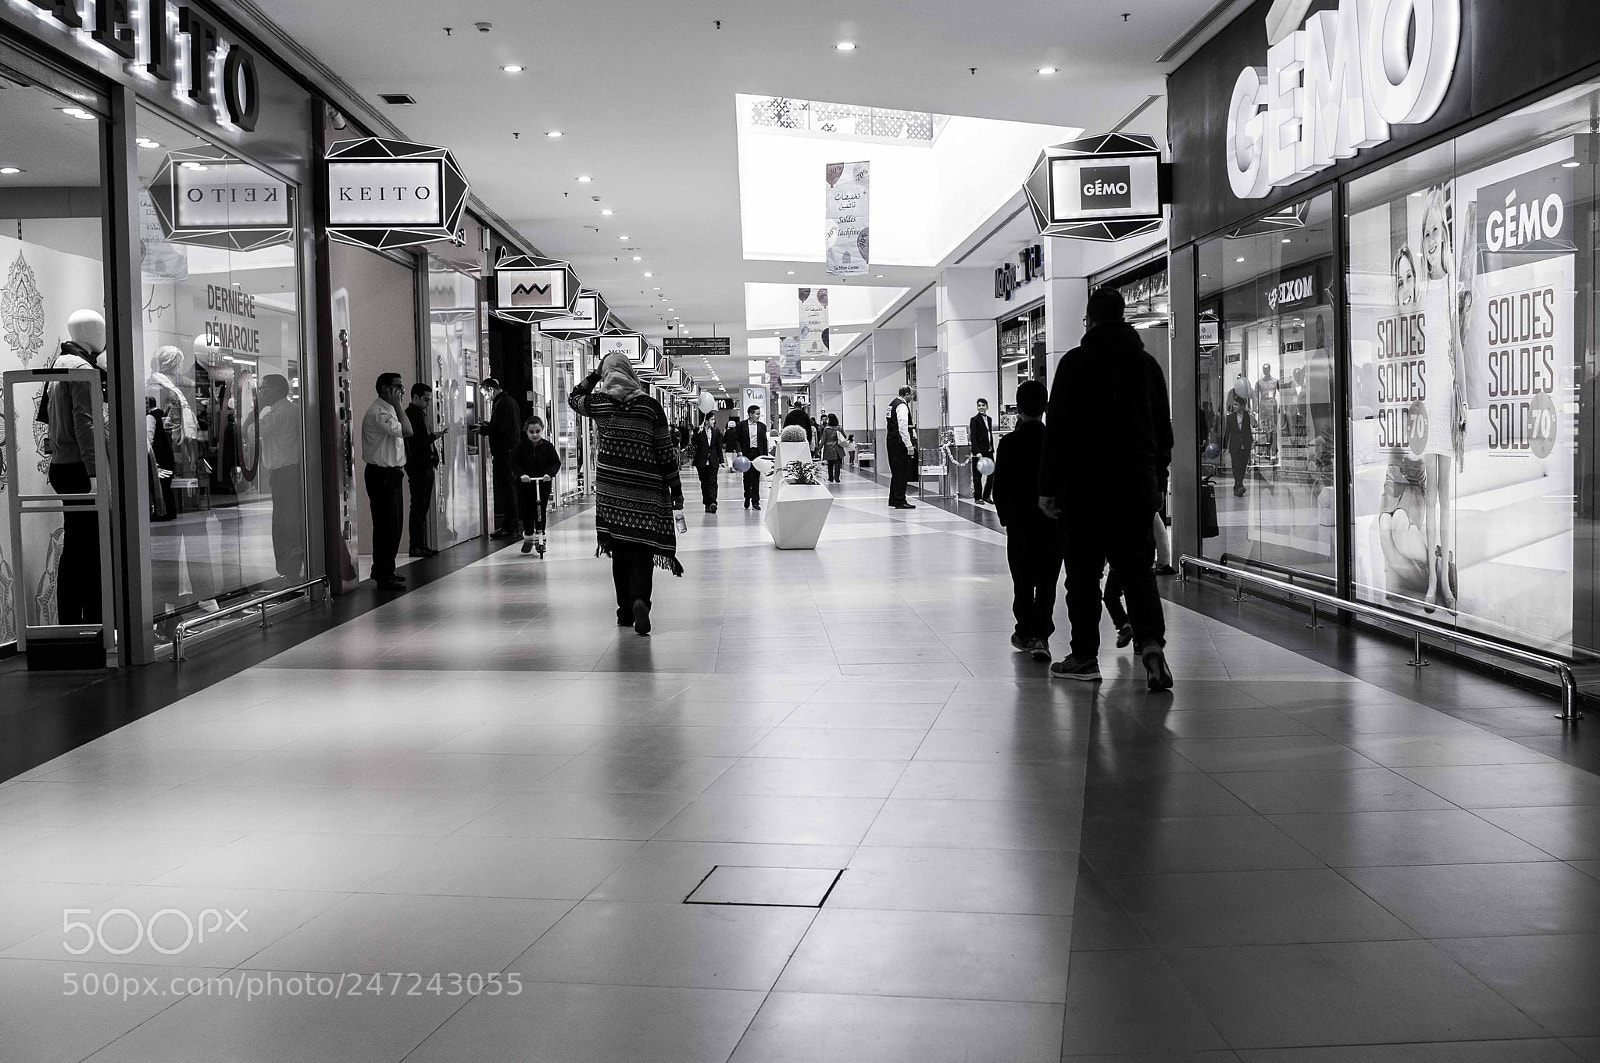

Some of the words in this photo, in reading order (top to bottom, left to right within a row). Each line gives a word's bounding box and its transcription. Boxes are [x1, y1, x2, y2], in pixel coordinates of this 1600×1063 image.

[1226, 0, 1460, 199] GÉMO
[339, 186, 431, 201] KEITO
[1083, 179, 1128, 196] GÉMO
[1486, 189, 1564, 252] GÉMO
[207, 284, 256, 319] DERNIÈRE
[1488, 288, 1554, 346] SOLDES
[205, 316, 259, 353] DÉMARQUE
[1377, 313, 1426, 360] SOLDES
[1378, 360, 1426, 403] SOLDES
[1488, 344, 1554, 398] SOLDES
[1379, 408, 1409, 447] SOLD
[1489, 402, 1530, 449] SOLD
